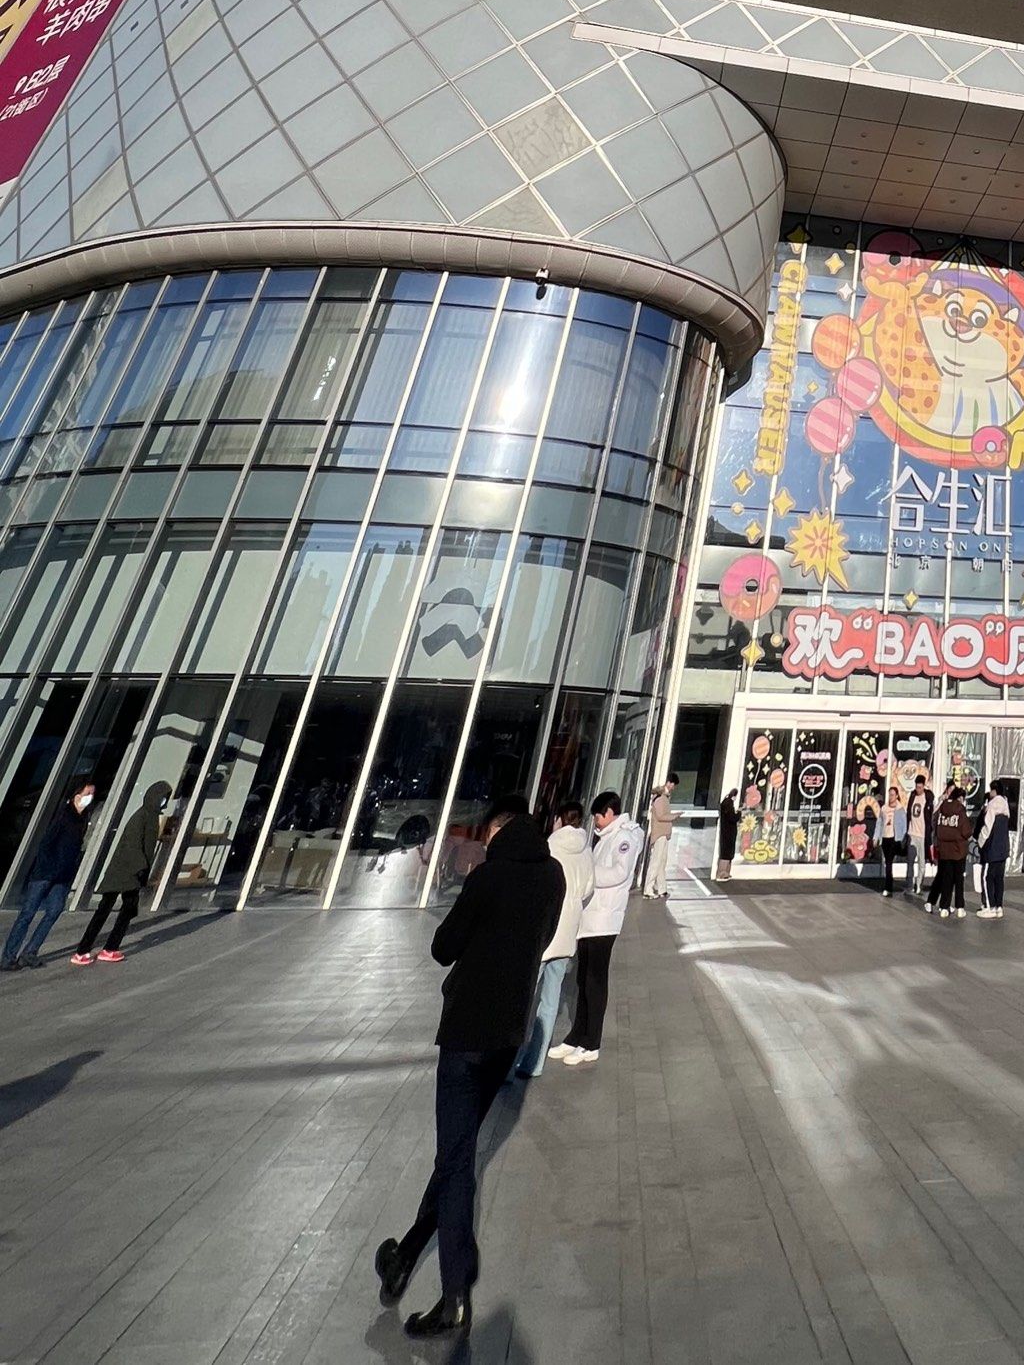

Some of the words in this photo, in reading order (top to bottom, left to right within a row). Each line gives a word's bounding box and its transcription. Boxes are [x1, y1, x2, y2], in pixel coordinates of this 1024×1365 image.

[880, 466, 1013, 536] 合生汇
[892, 537, 968, 552] HOPSON
[979, 541, 1013, 554] ONE
